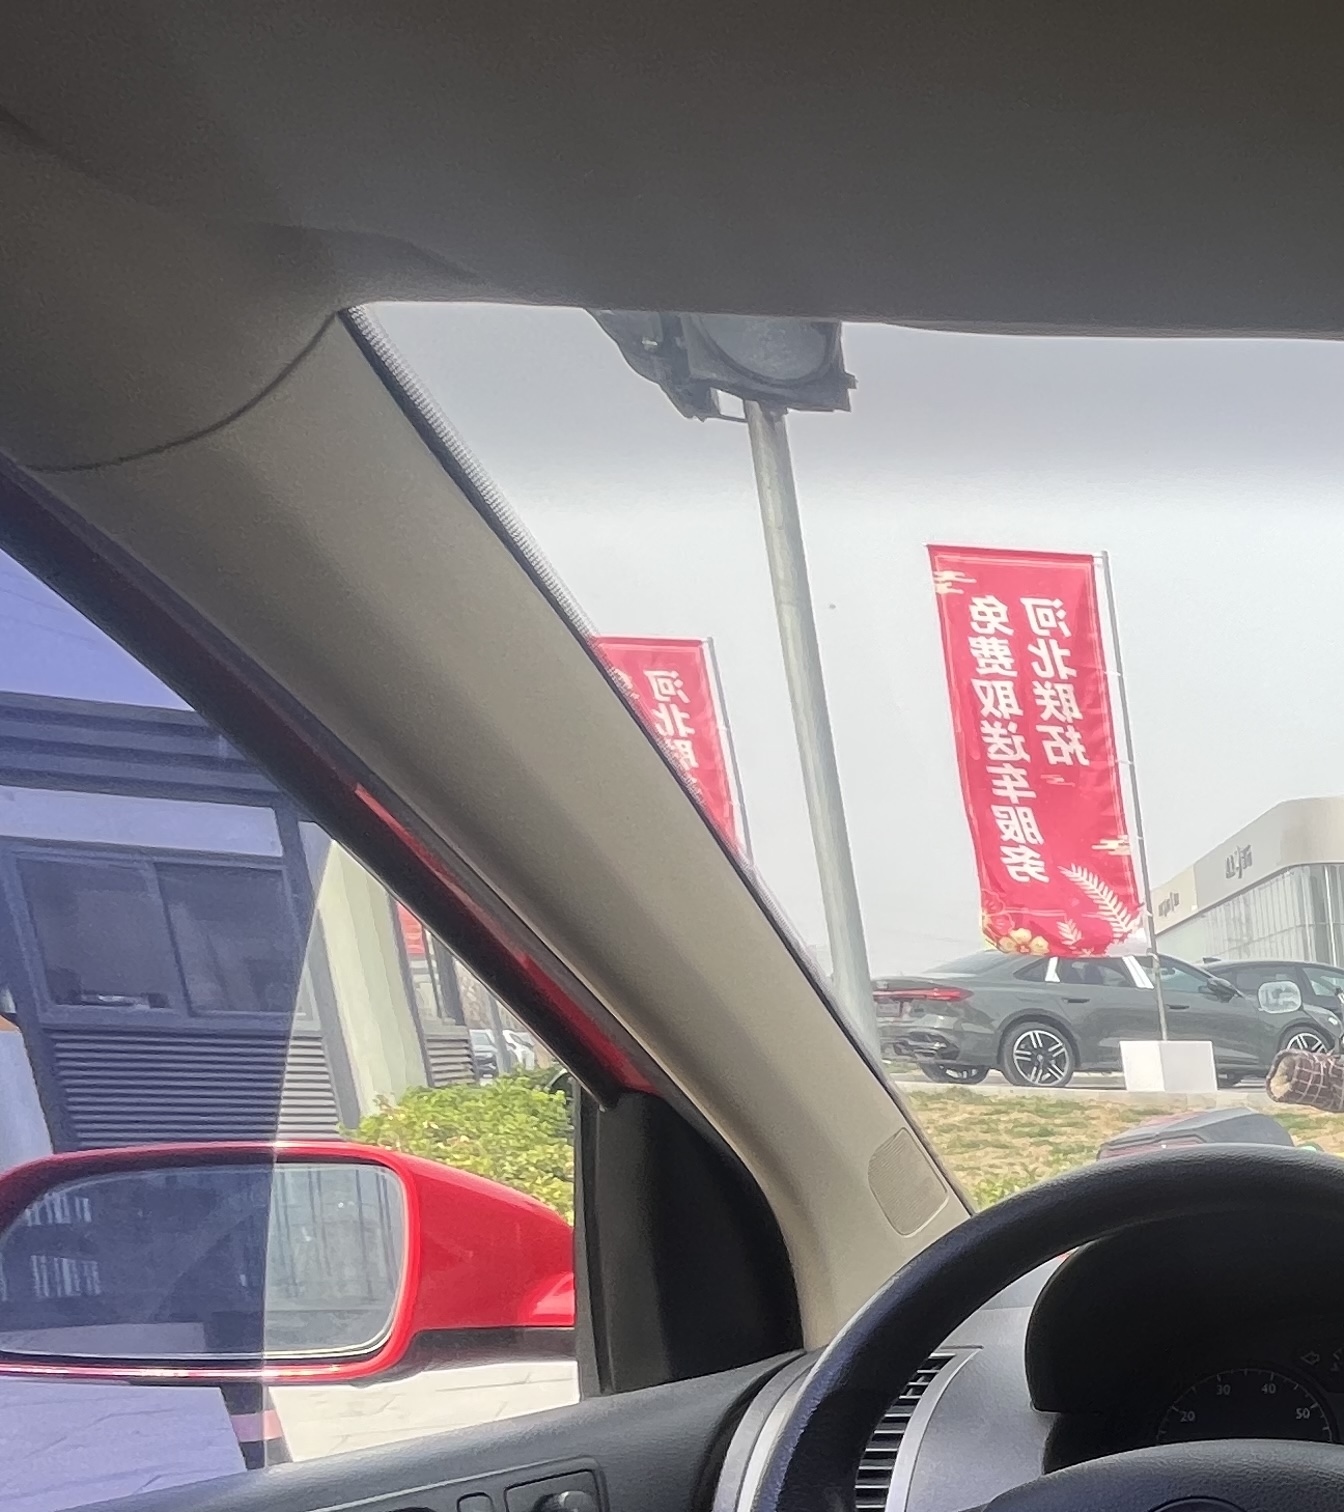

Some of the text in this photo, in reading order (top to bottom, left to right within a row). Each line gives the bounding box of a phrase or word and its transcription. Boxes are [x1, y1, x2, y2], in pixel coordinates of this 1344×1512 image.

[1217, 1383, 1231, 1396] 30
[1261, 1383, 1276, 1395] 40
[1180, 1411, 1195, 1422] 20
[1295, 1407, 1310, 1420] 50
